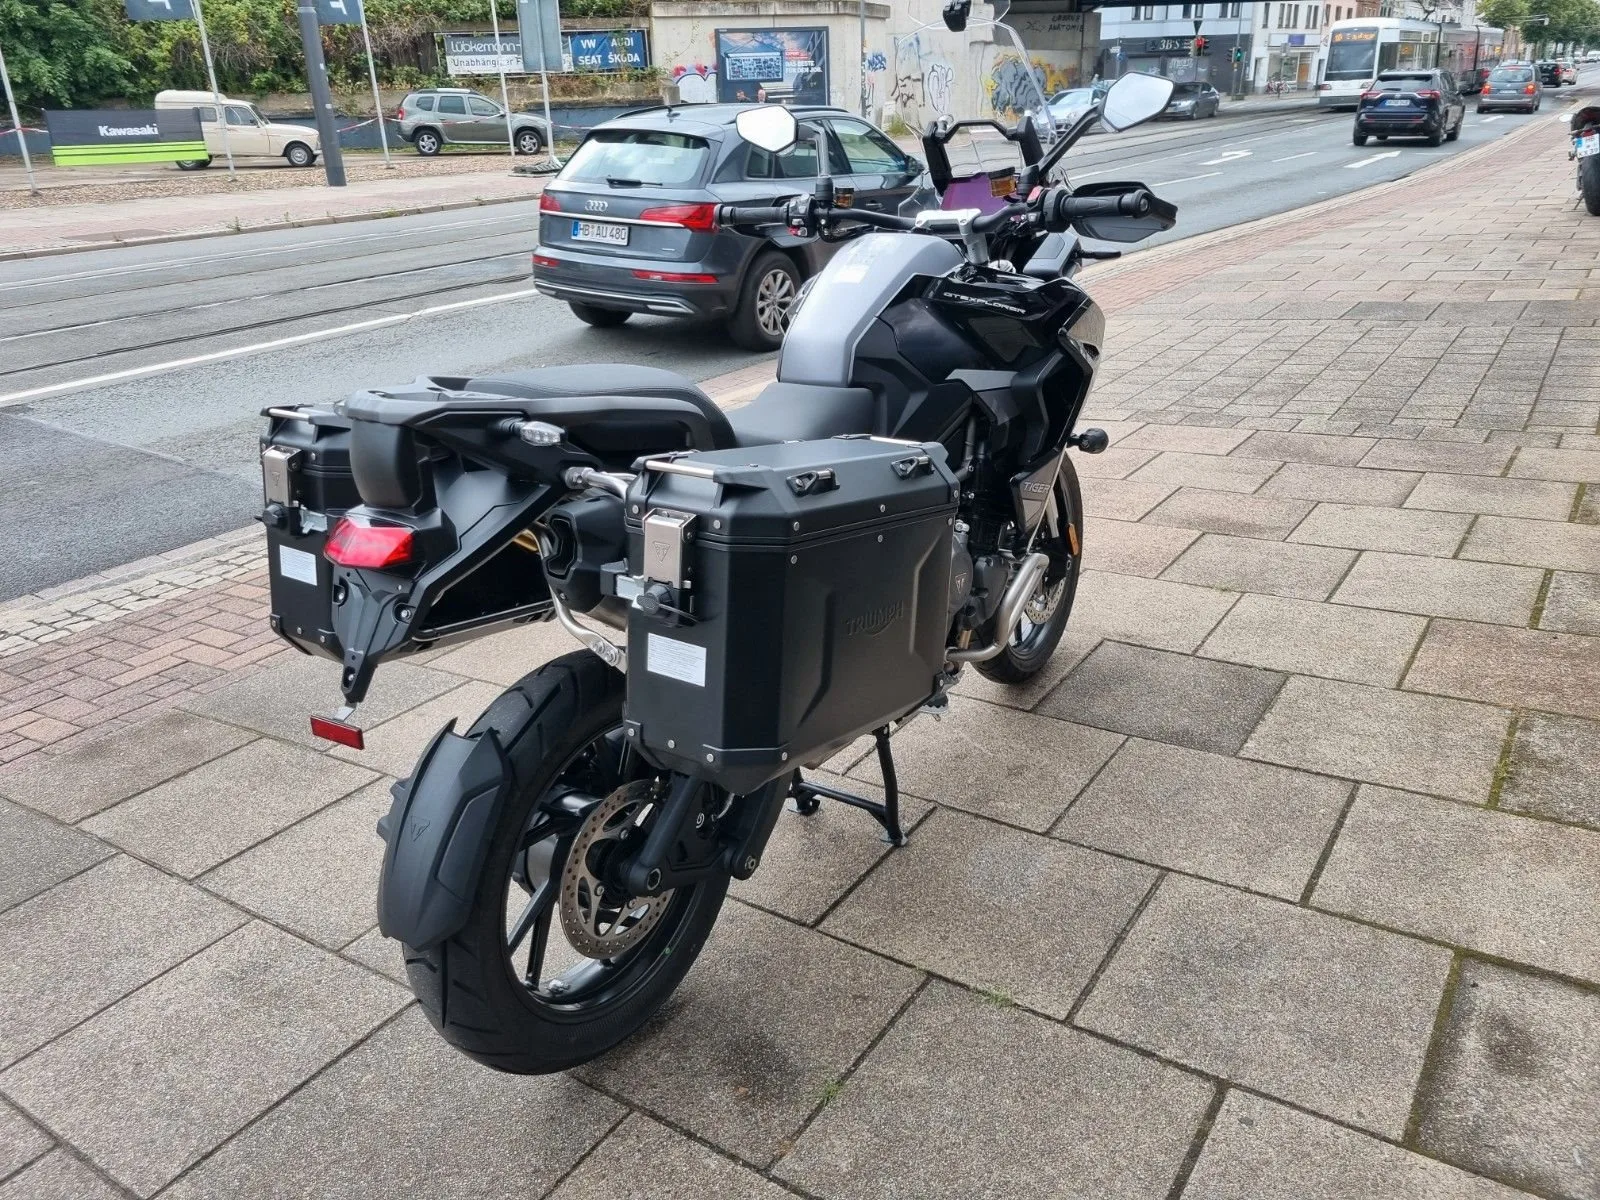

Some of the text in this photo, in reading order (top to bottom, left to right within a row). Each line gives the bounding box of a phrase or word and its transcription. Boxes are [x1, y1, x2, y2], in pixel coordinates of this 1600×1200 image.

[581, 37, 634, 49] VW AUDI
[578, 51, 641, 65] SEAT ŠKODA
[98, 123, 159, 137] Kawasaki
[579, 223, 591, 237] HB
[596, 224, 608, 239] AU
[1023, 481, 1051, 494] TIGER
[846, 599, 904, 637] TRIUMPH
